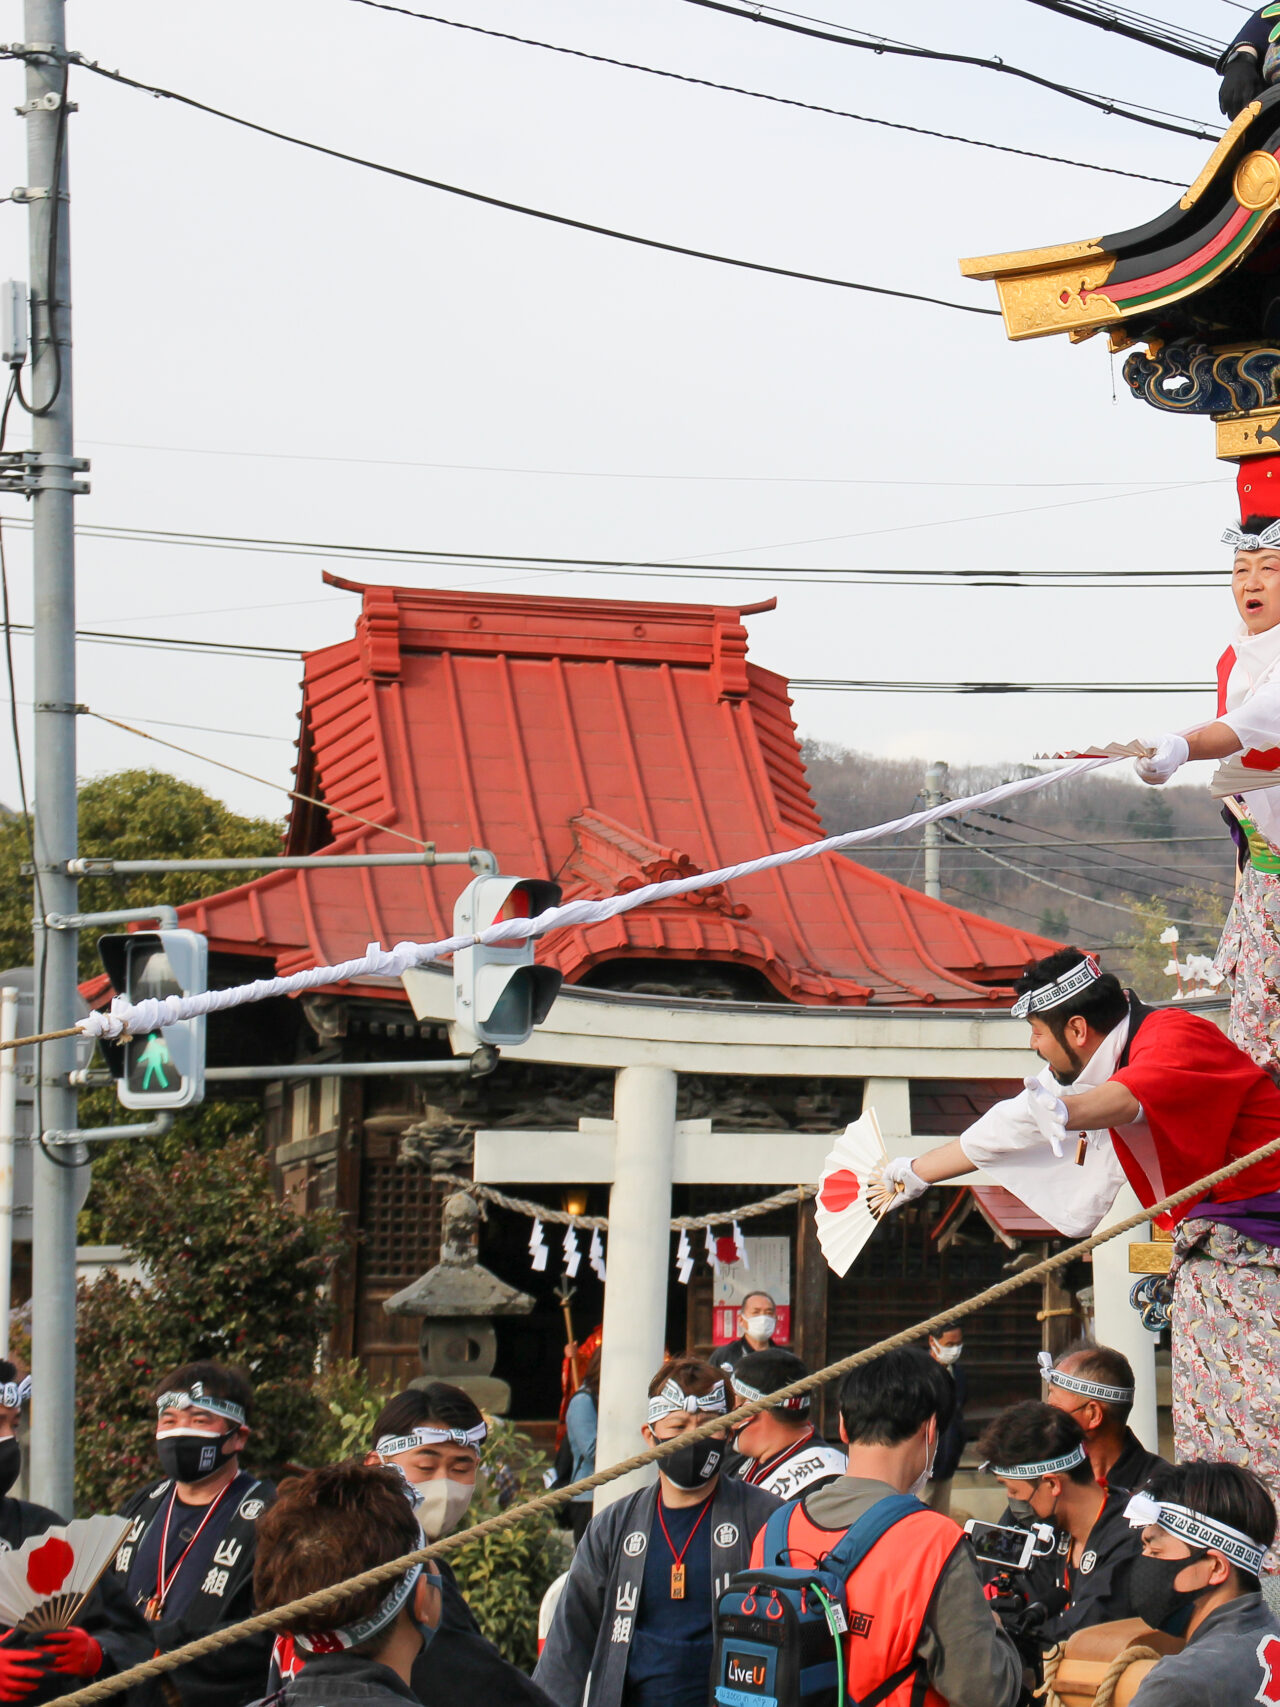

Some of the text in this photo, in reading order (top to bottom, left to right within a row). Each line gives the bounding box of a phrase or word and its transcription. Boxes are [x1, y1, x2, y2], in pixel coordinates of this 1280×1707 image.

[201, 1537, 243, 1598] 山組
[610, 1580, 638, 1644] 山組
[728, 1659, 766, 1686] LiveU
